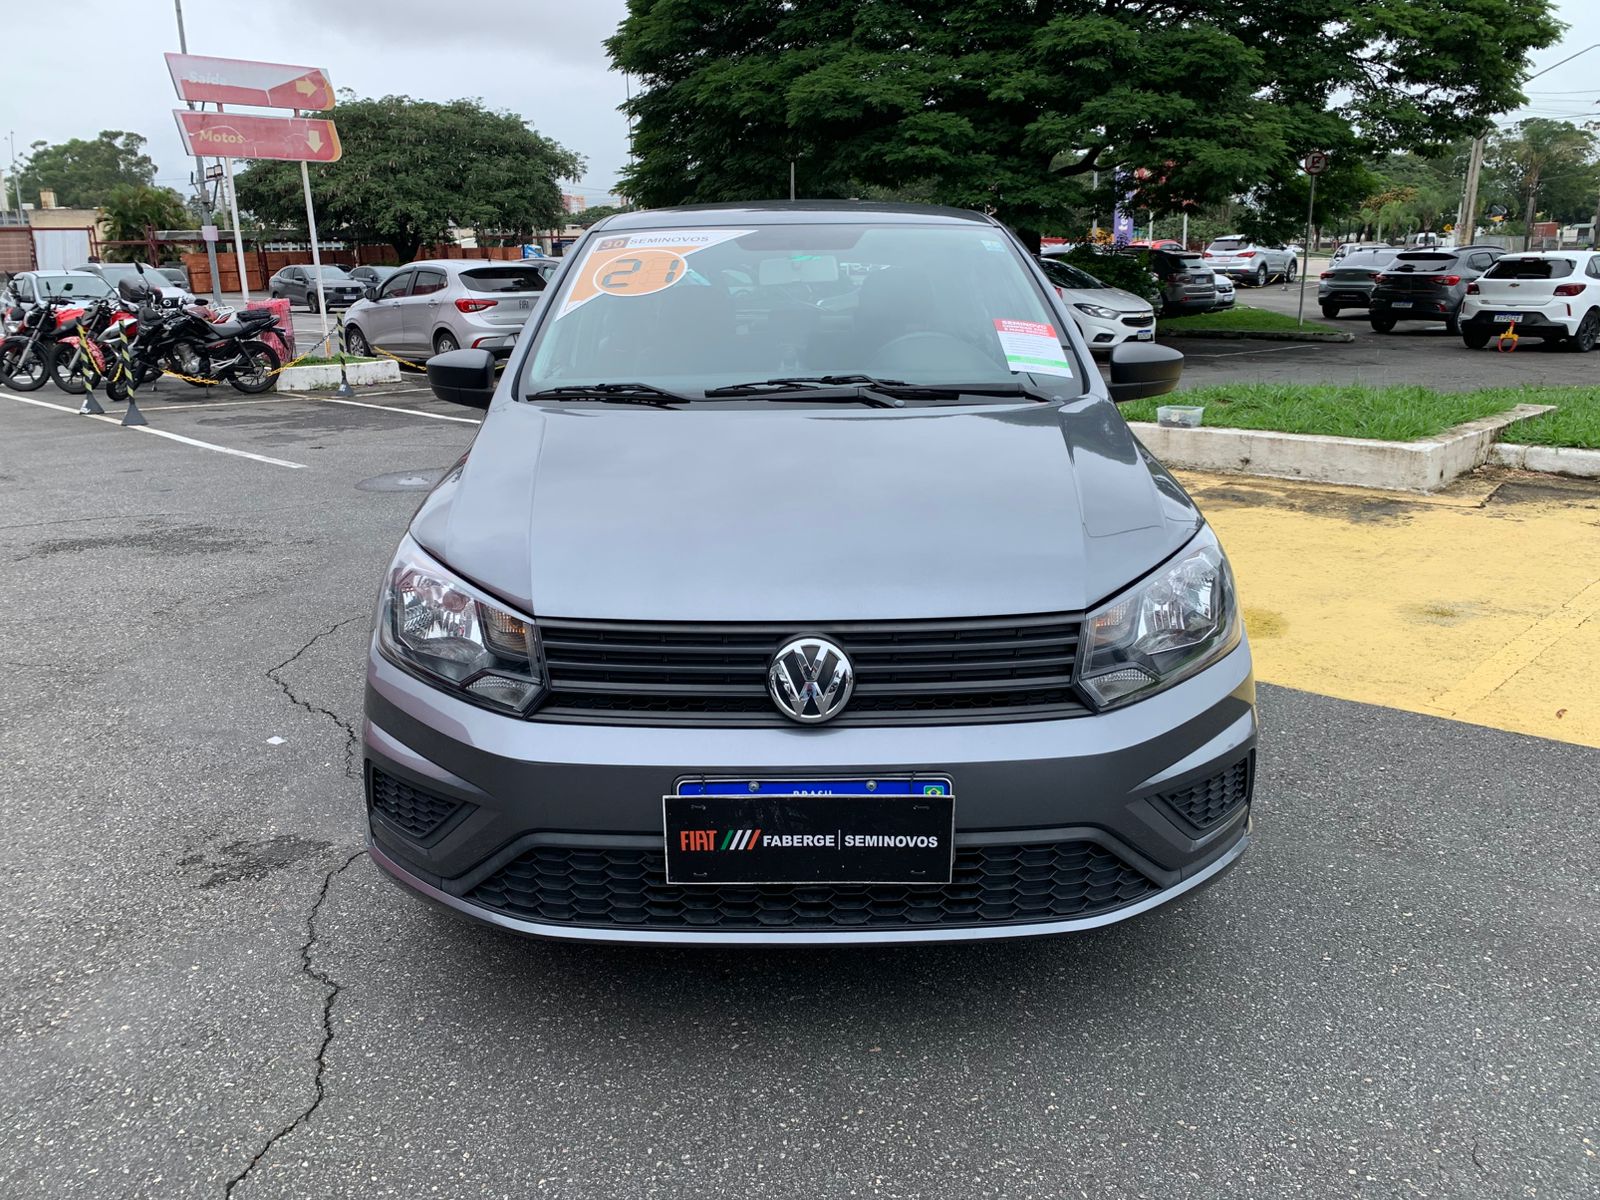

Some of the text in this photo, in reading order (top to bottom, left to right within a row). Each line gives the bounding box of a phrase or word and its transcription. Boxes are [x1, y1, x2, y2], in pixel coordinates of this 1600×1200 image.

[199, 130, 244, 144] Motos
[630, 236, 710, 245] SEMINOVOS
[602, 258, 680, 288] 21
[680, 830, 938, 851] FIAT FABERGE SEMINOVOS
